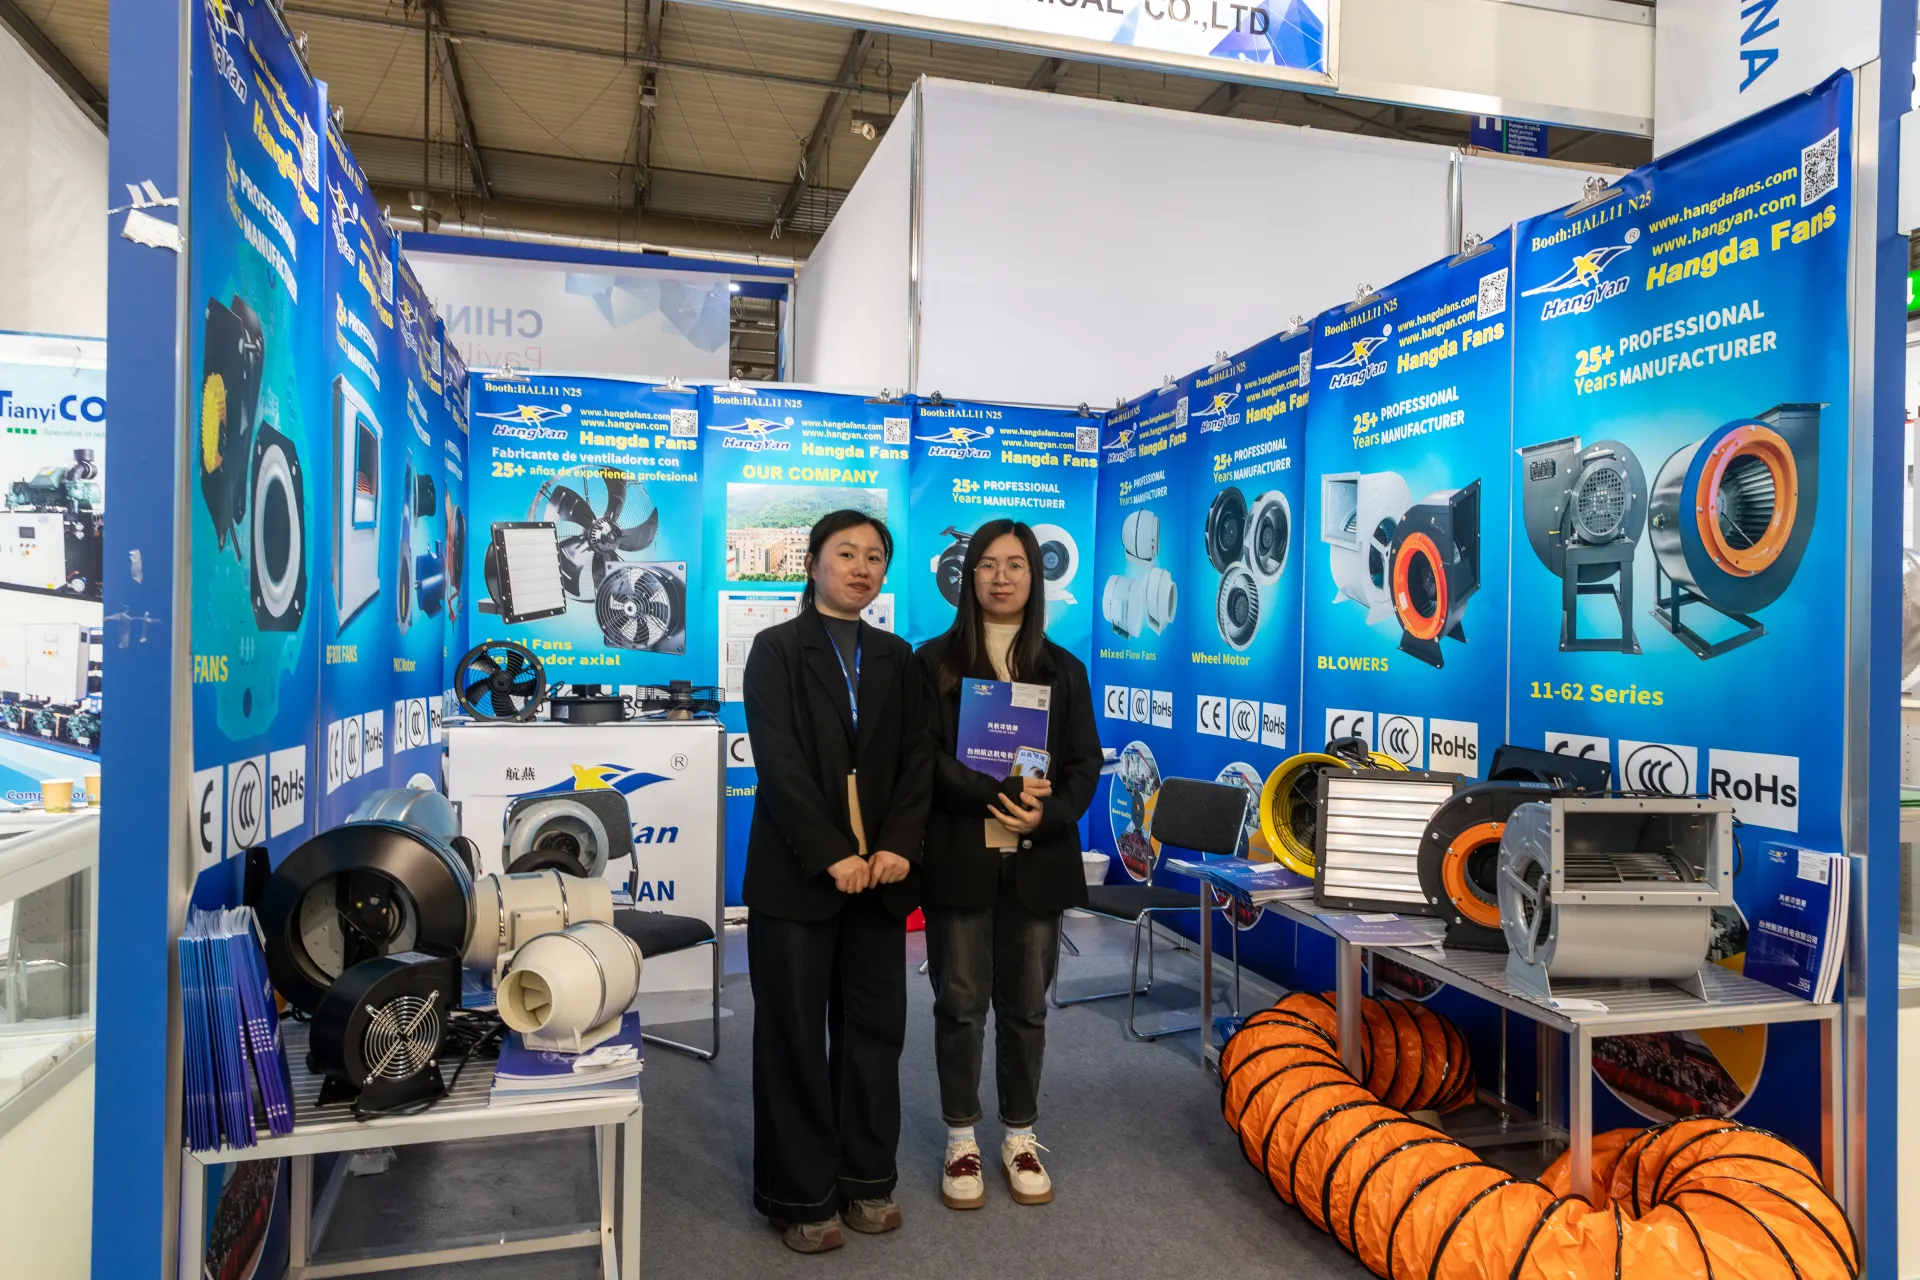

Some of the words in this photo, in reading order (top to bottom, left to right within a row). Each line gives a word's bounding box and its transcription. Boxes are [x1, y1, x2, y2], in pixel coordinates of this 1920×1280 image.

[1739, 0, 1779, 94] NA
[1628, 189, 1652, 213] N25
[1648, 165, 1798, 235] www.hangdafans.com
[1651, 191, 1797, 257] www.hangyan.com
[1645, 236, 1759, 291] Hangda
[1771, 203, 1837, 251] Fans
[1383, 298, 1398, 318] N25
[1541, 275, 1630, 321] HangYan
[1397, 294, 1478, 333] www.hangdafans.com
[1399, 310, 1476, 348] www.hangyan.com
[1574, 345, 1614, 377] 25+
[1619, 299, 1765, 356] PROFESSIONAL
[1397, 339, 1458, 374] Hangda
[1462, 323, 1505, 352] Fans
[1236, 361, 1246, 375] N25
[1574, 371, 1617, 396] Years
[1619, 330, 1777, 386] MANUFACTURER
[1244, 363, 1300, 390] www.hangdafans.com
[1329, 361, 1388, 389] HangYan
[562, 387, 582, 397] N25
[1246, 378, 1299, 403] www.hangyan.com
[0, 390, 106, 423] TianyiCO
[784, 400, 802, 408] N25
[1246, 399, 1287, 424] Hangda
[1353, 412, 1378, 435] 25+
[1380, 386, 1459, 422] PROFESSIONAL
[580, 408, 670, 422] www.hangdafans.com
[580, 418, 668, 432] www.hangyan.com
[801, 419, 884, 431] www.hangdafans.com
[986, 410, 1002, 420] N25
[1200, 412, 1240, 434] HangYan
[492, 424, 568, 440] HangYan
[802, 429, 882, 441] www.hangyan.com
[1000, 428, 1075, 438] www.hangdafans.com
[1352, 432, 1380, 450] Years
[1381, 410, 1465, 445] MANUFACTURER
[580, 431, 650, 450] Hangda
[655, 435, 698, 451] Fans
[722, 436, 790, 452] HangYan
[802, 442, 864, 460] Hangda
[870, 446, 909, 460] Fans
[1002, 438, 1074, 450] www.hangyan.com
[1138, 438, 1168, 458] Hangda
[1169, 432, 1187, 448] Fans
[492, 447, 560, 462] Fabricante
[562, 450, 576, 462] de
[580, 451, 655, 466] ventiladores
[658, 458, 680, 467] con
[928, 446, 992, 460] HangYan
[1002, 451, 1058, 468] Hangda
[1063, 454, 1098, 468] Fans
[1214, 454, 1232, 472] 25+
[1234, 438, 1288, 462] PROFESSIONAL
[492, 462, 526, 478] 25+
[530, 464, 556, 477] años
[558, 466, 572, 477] de
[574, 467, 636, 482] experiencia
[638, 468, 698, 483] profesional
[743, 465, 783, 480] OUR
[788, 466, 880, 484] COMPANY
[1213, 471, 1233, 484] Years
[1234, 457, 1291, 481] MANUFACTURER
[952, 478, 980, 493] 25+
[984, 480, 1060, 494] PROFESSIONAL
[1120, 480, 1132, 496] 25+
[1134, 470, 1166, 488] PROFESSIONAL
[952, 492, 982, 504] Years
[984, 496, 1066, 509] MANUFACTURER
[1119, 496, 1133, 506] Years
[1133, 486, 1168, 504] MANUFACTURER
[532, 638, 572, 650] Fans
[580, 654, 620, 666] axial
[1100, 649, 1124, 660] Mixed
[1126, 650, 1140, 660] Flow
[1142, 650, 1156, 661] Fans
[1192, 652, 1221, 664] Wheel
[1222, 654, 1250, 666] Motor
[1317, 656, 1389, 672] BLOWERS
[193, 655, 229, 684] FANS
[1530, 681, 1584, 702] 11-62
[1590, 684, 1664, 706] Series
[430, 708, 442, 730] Ro
[1152, 700, 1172, 718] RoHs
[1262, 714, 1286, 736] RoHs
[364, 727, 383, 755] RoHs
[1431, 732, 1477, 760] RoHs
[966, 747, 1015, 760] 台州航达机电有
[506, 766, 536, 781] 航燕
[271, 769, 304, 810] RoHs
[1710, 768, 1798, 808] RoHs
